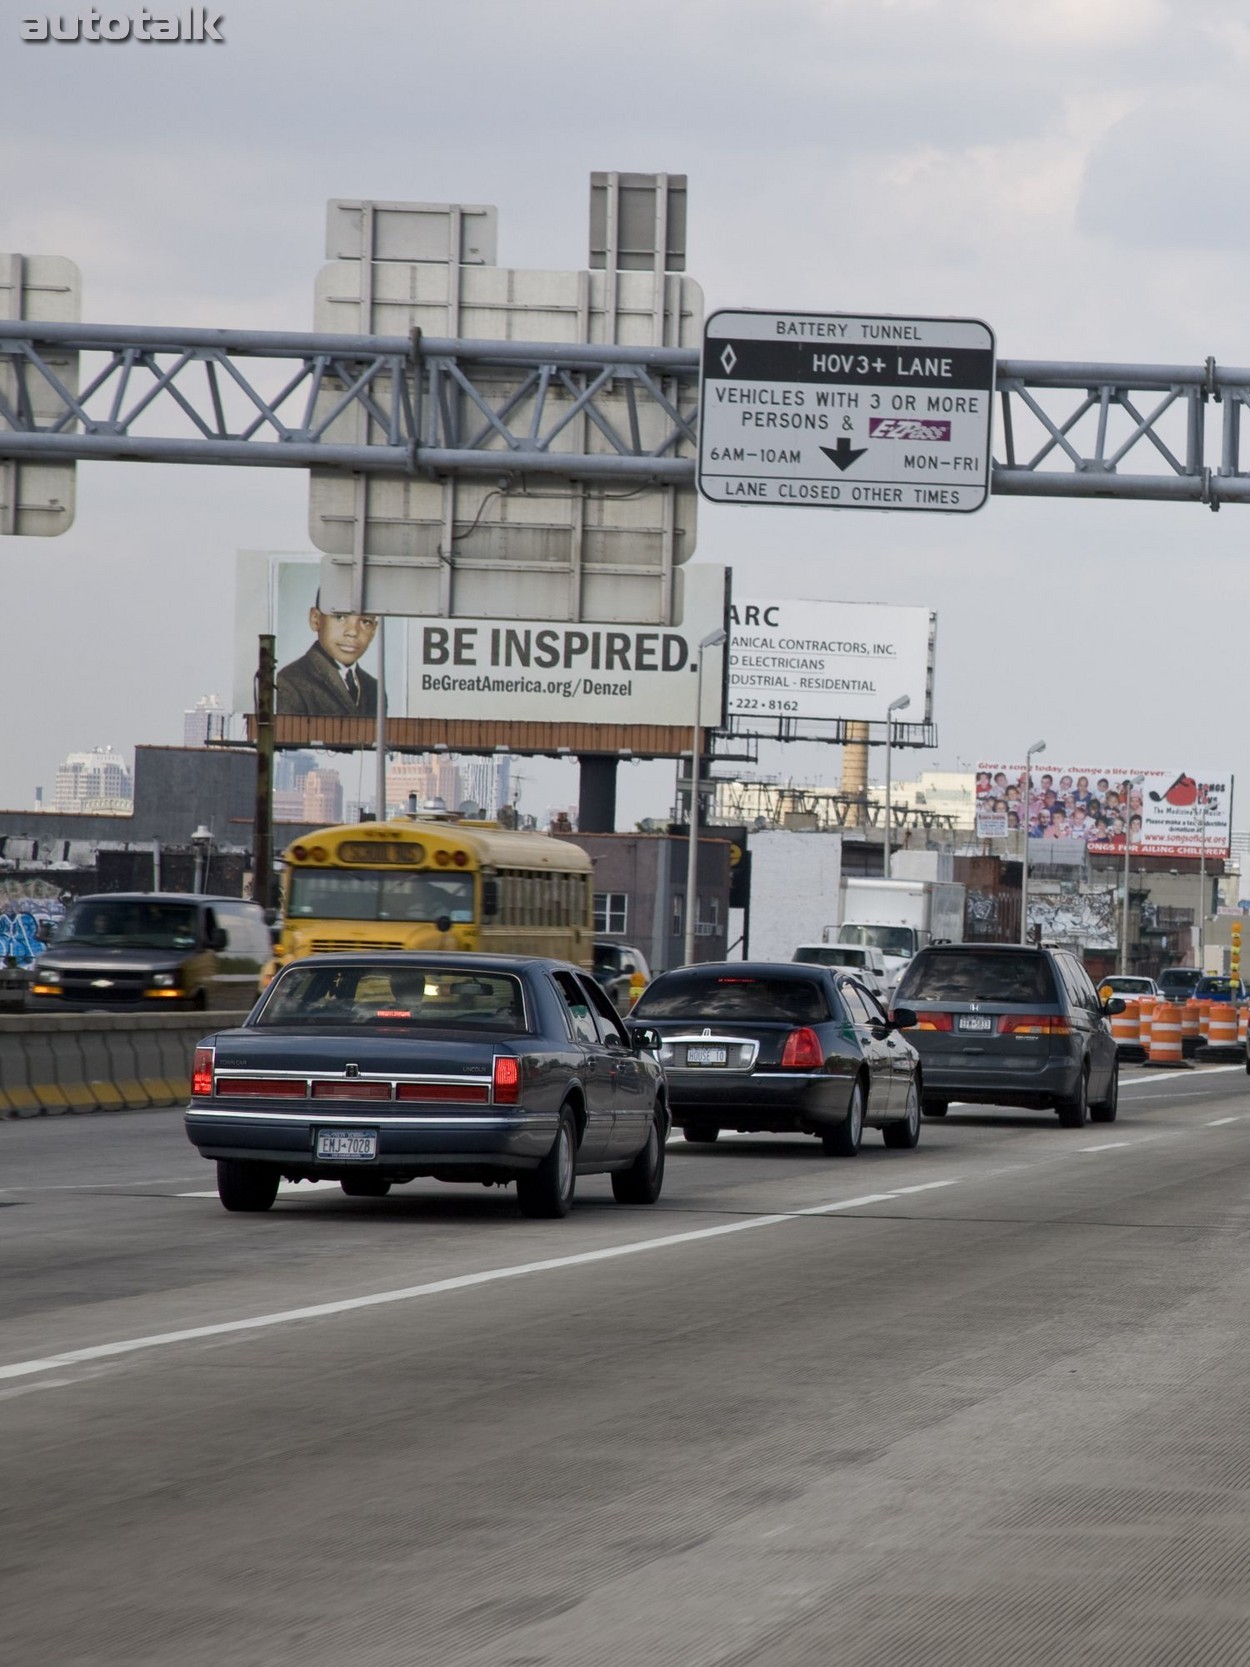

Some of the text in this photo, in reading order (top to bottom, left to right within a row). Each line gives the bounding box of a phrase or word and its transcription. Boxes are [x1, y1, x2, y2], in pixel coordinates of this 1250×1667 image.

[776, 321, 922, 341] BATTERY TUNNEL
[897, 357, 953, 377] LANE
[715, 387, 979, 413] VEHICLES WITH 3 OR MORE
[741, 411, 829, 430] PERSONS
[841, 415, 854, 431] &
[904, 454, 979, 472] MON-FRI
[725, 481, 960, 505] LANE CLOSED OTHER TIMES
[422, 627, 698, 673] BE INSPIRED.
[731, 637, 897, 655] ANICAL CONTRACTORS, INC.
[742, 656, 825, 670] ELECTRICIANS
[421, 674, 632, 698] BeGreatAmerica.org/Denzel
[729, 674, 790, 688] DUSTRIAL
[800, 678, 876, 692] RESIDENTIAL
[736, 699, 798, 711] 222 8162
[978, 762, 998, 770] Give
[1067, 767, 1101, 775] change
[1198, 783, 1225, 792] SONGS
[1154, 806, 1164, 815] The
[1118, 844, 1138, 853] FOR
[1141, 845, 1175, 854] AILING
[462, 1066, 488, 1074] LINCOLN
